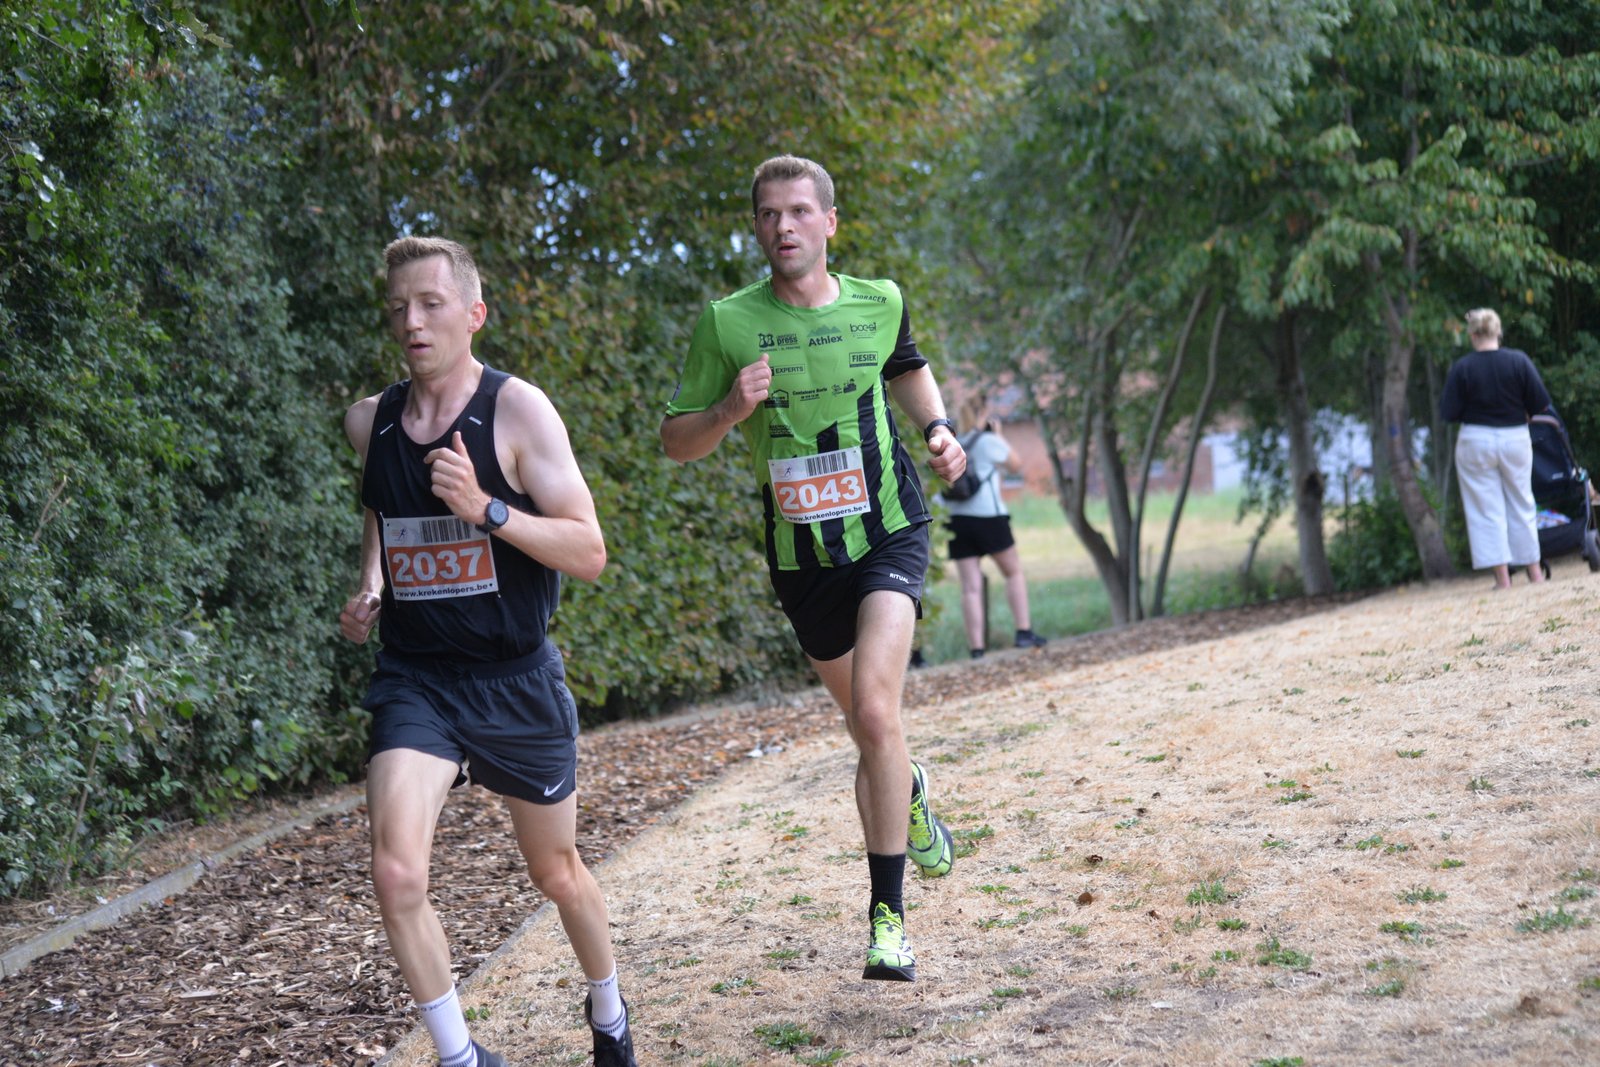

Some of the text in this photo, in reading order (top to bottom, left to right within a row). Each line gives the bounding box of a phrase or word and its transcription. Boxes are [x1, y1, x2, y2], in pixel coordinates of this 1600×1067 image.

[851, 294, 887, 304] BIORACER
[776, 336, 799, 347] press
[808, 335, 843, 347] Athlex
[775, 366, 804, 374] EXPERTS
[779, 475, 862, 511] 2043
[788, 504, 863, 522] www.krekenlopers.be
[392, 547, 484, 583] 2037
[889, 572, 910, 585] RITUAL
[398, 583, 488, 598] www.krekenlopers.be
